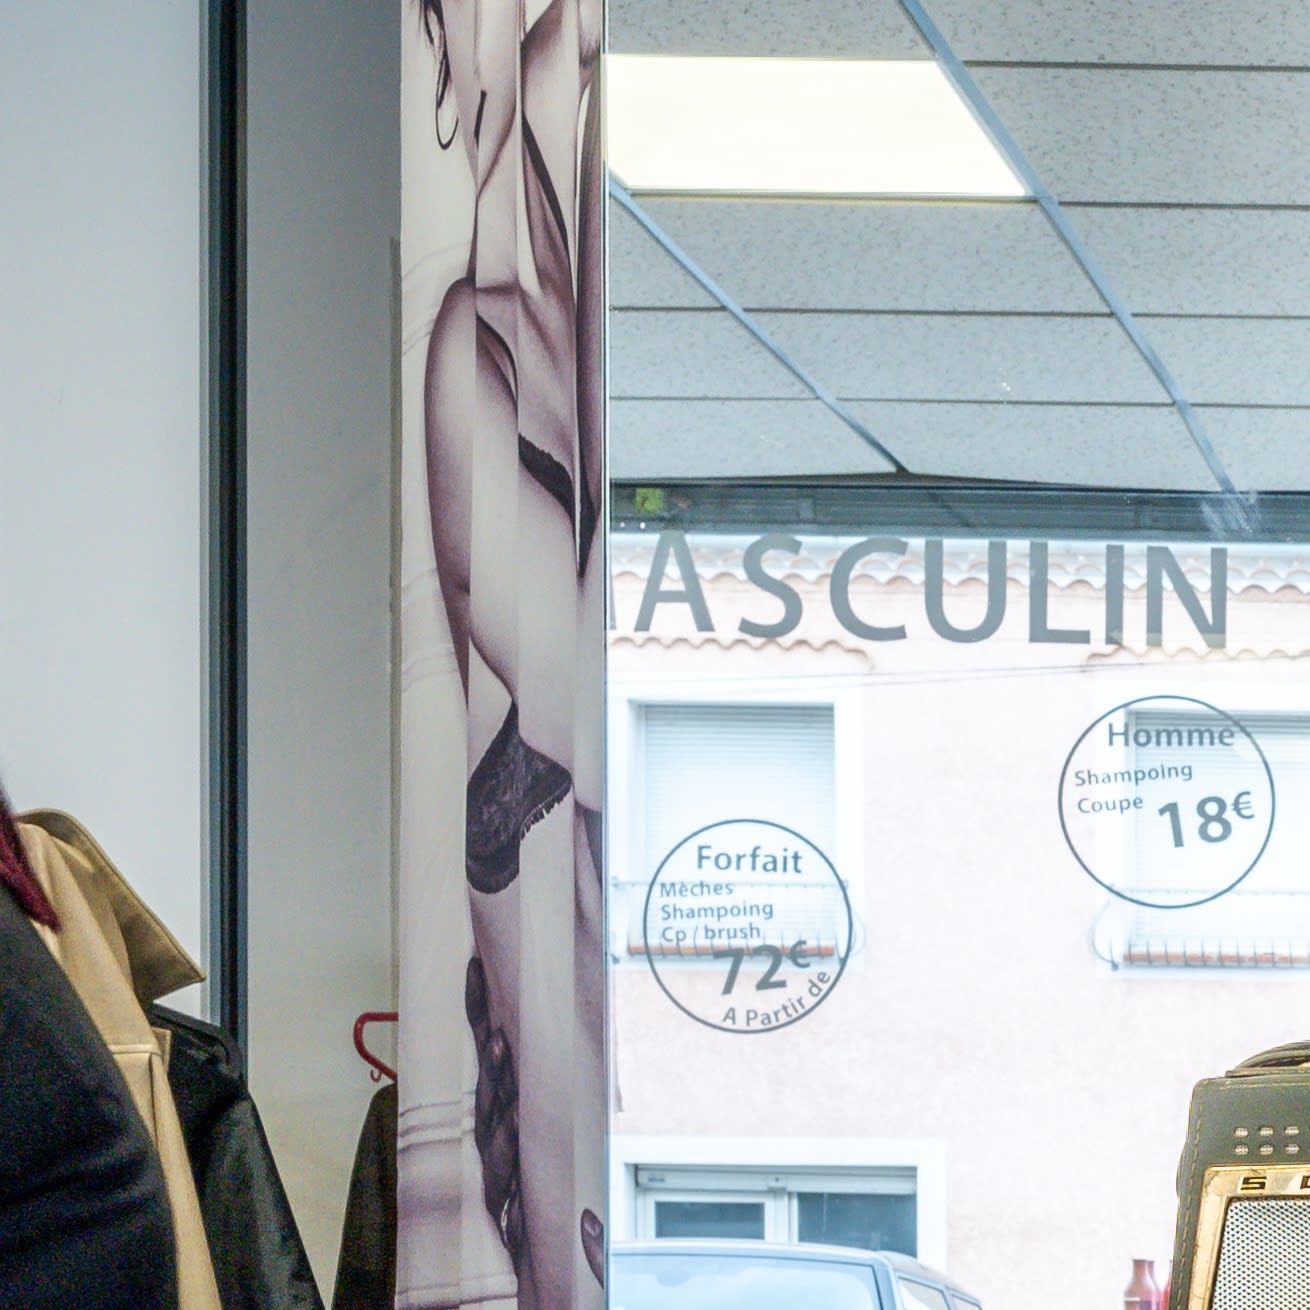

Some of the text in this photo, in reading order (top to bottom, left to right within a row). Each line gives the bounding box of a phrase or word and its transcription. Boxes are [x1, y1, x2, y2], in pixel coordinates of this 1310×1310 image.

[608, 530, 1229, 650] ASCULIN
[1108, 722, 1235, 747] Homme
[1075, 764, 1193, 787] Shampoing
[1077, 796, 1143, 814] Coupe
[1158, 791, 1255, 848] 18€
[697, 845, 802, 874] Forfait
[660, 880, 734, 897] Mèches
[660, 901, 774, 922] Shampoing
[662, 927, 687, 944] Cp
[704, 923, 761, 939] brush
[713, 940, 811, 996] 72€
[746, 996, 806, 1026] Partir
[808, 971, 831, 997] de
